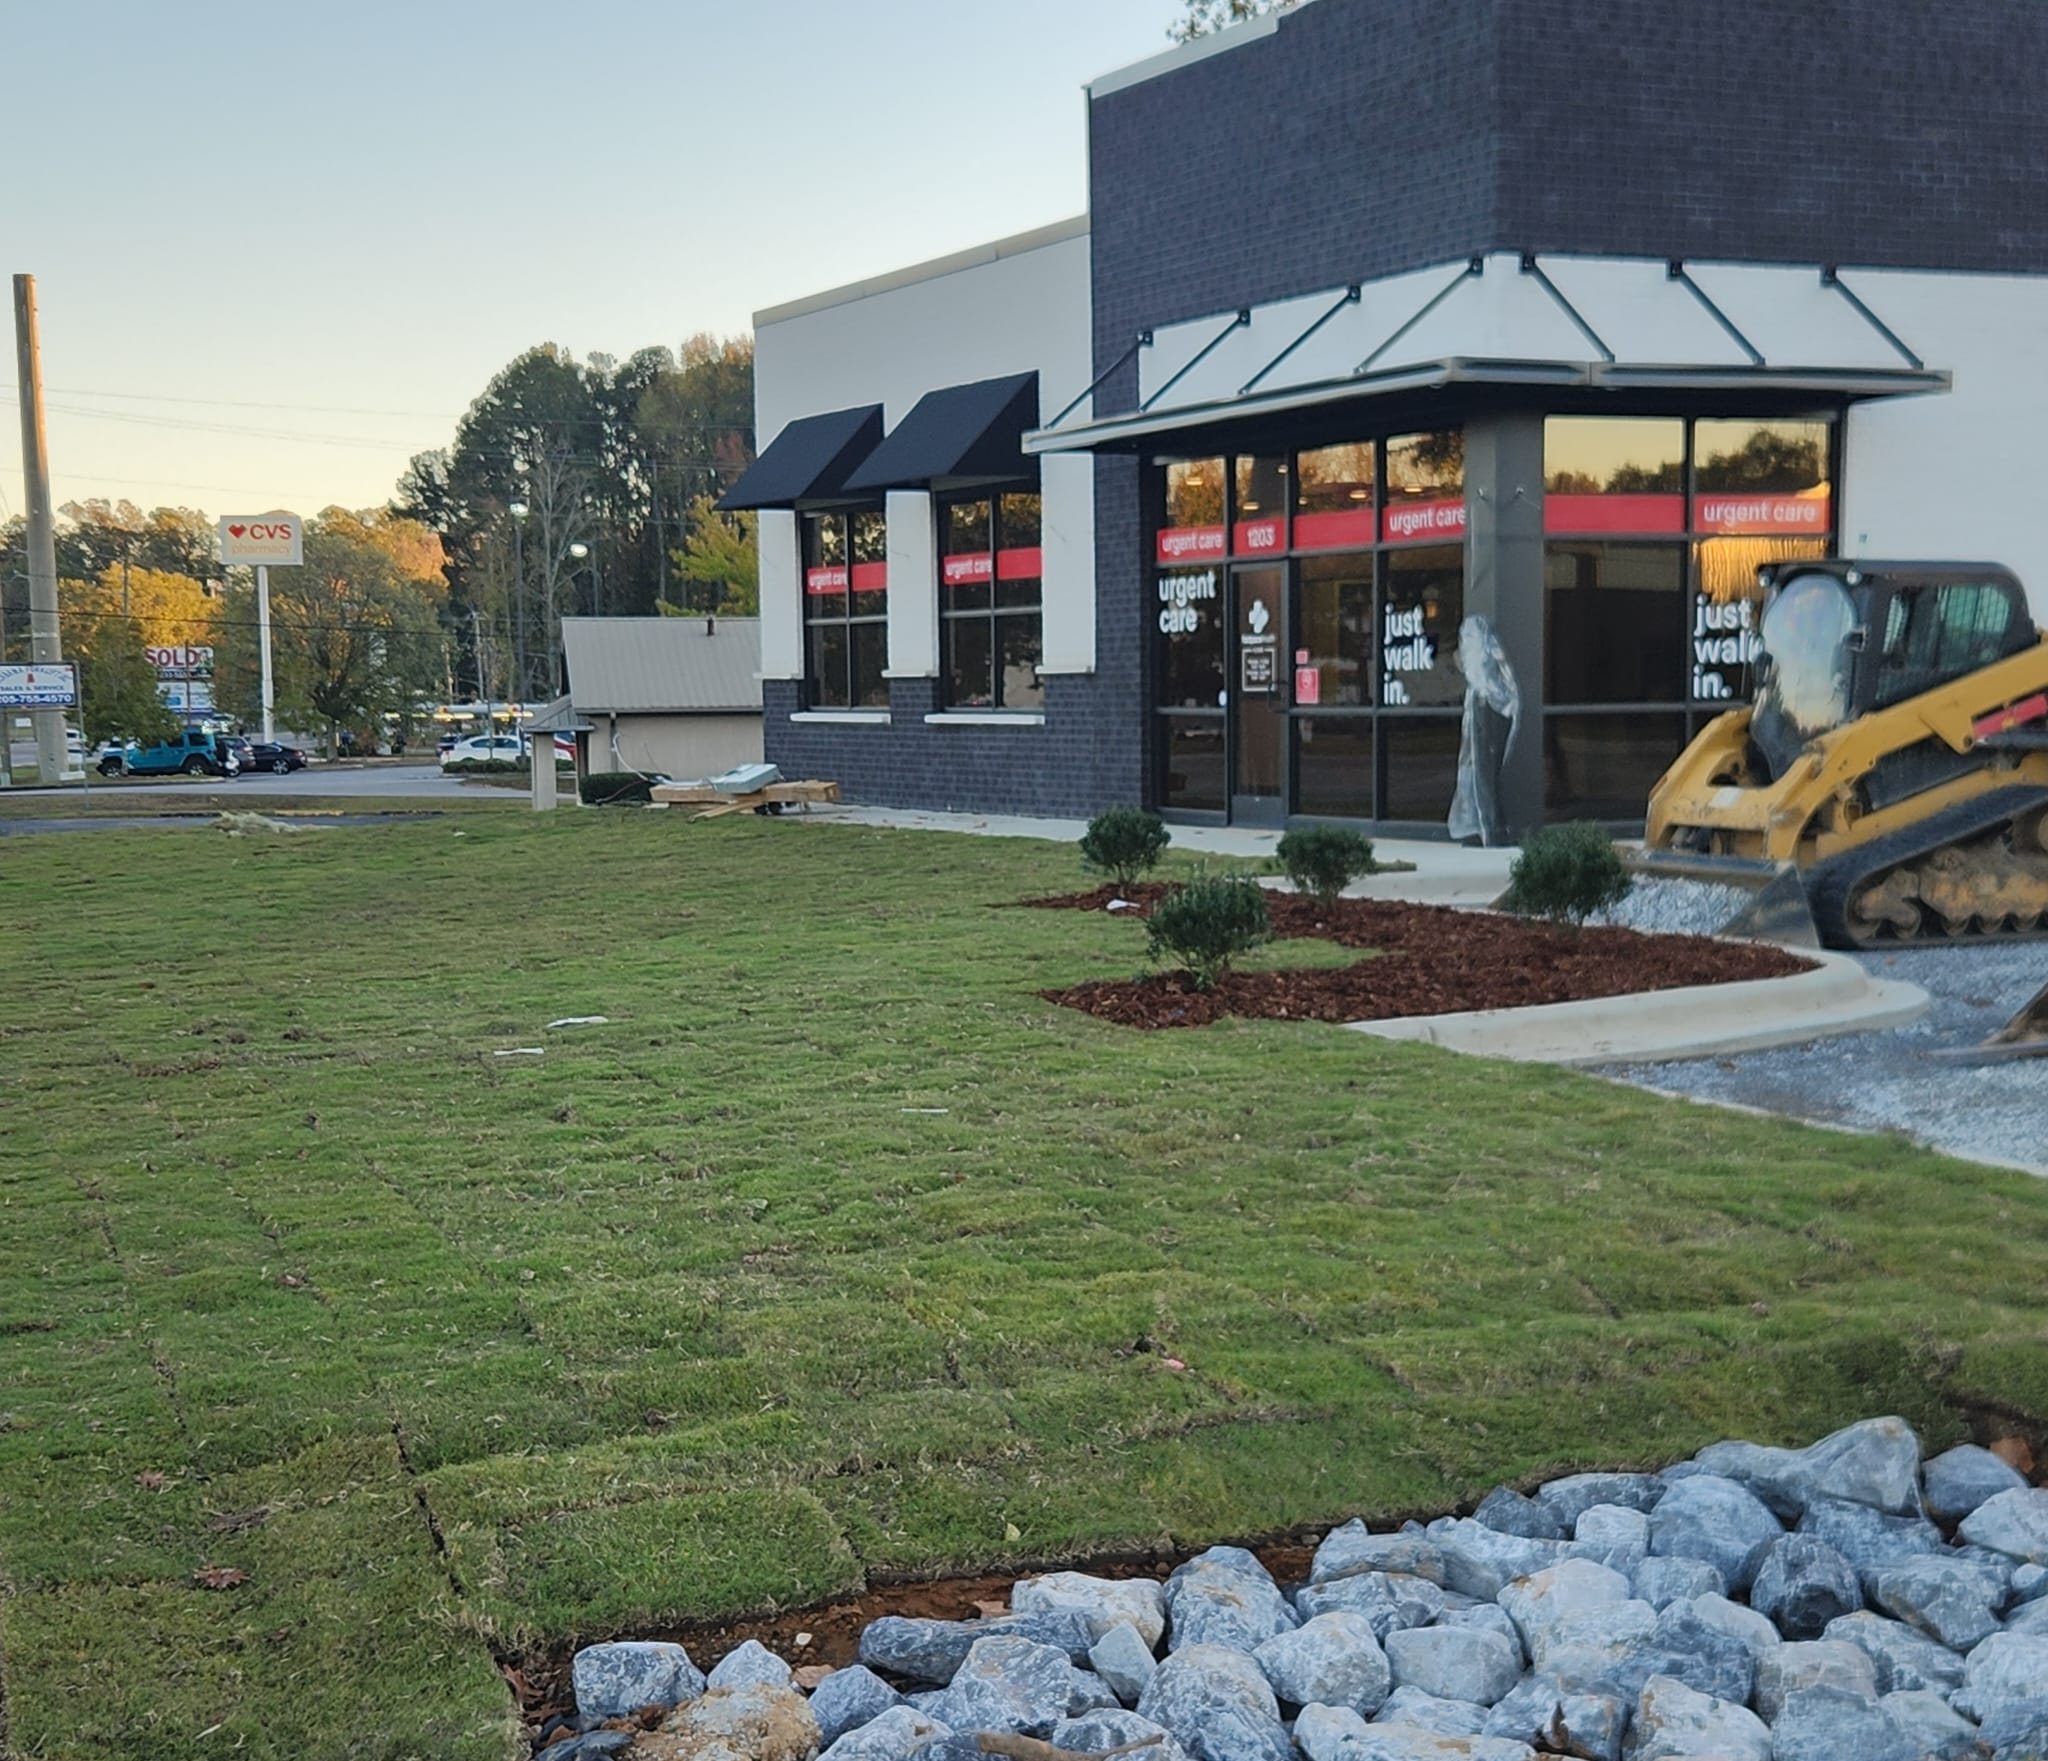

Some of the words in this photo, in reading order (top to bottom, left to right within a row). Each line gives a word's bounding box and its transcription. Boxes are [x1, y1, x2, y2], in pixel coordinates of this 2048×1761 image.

[1389, 508, 1433, 535] urgent
[1436, 507, 1466, 527] care
[1703, 502, 1769, 527] urgent
[1773, 503, 1817, 522] care
[249, 523, 292, 540] CVS
[1162, 532, 1197, 556] urgent
[1198, 533, 1223, 550] care
[1247, 527, 1275, 548] 1203
[809, 572, 832, 590] urgent
[945, 559, 973, 580] urgent
[1159, 569, 1216, 607] urgent
[1159, 608, 1198, 633] care
[1384, 602, 1424, 645] just
[1694, 593, 1752, 637] just
[145, 648, 199, 667] SOLD
[1384, 635, 1434, 670] walk
[1384, 672, 1410, 705] in.
[1693, 664, 1733, 699] in.
